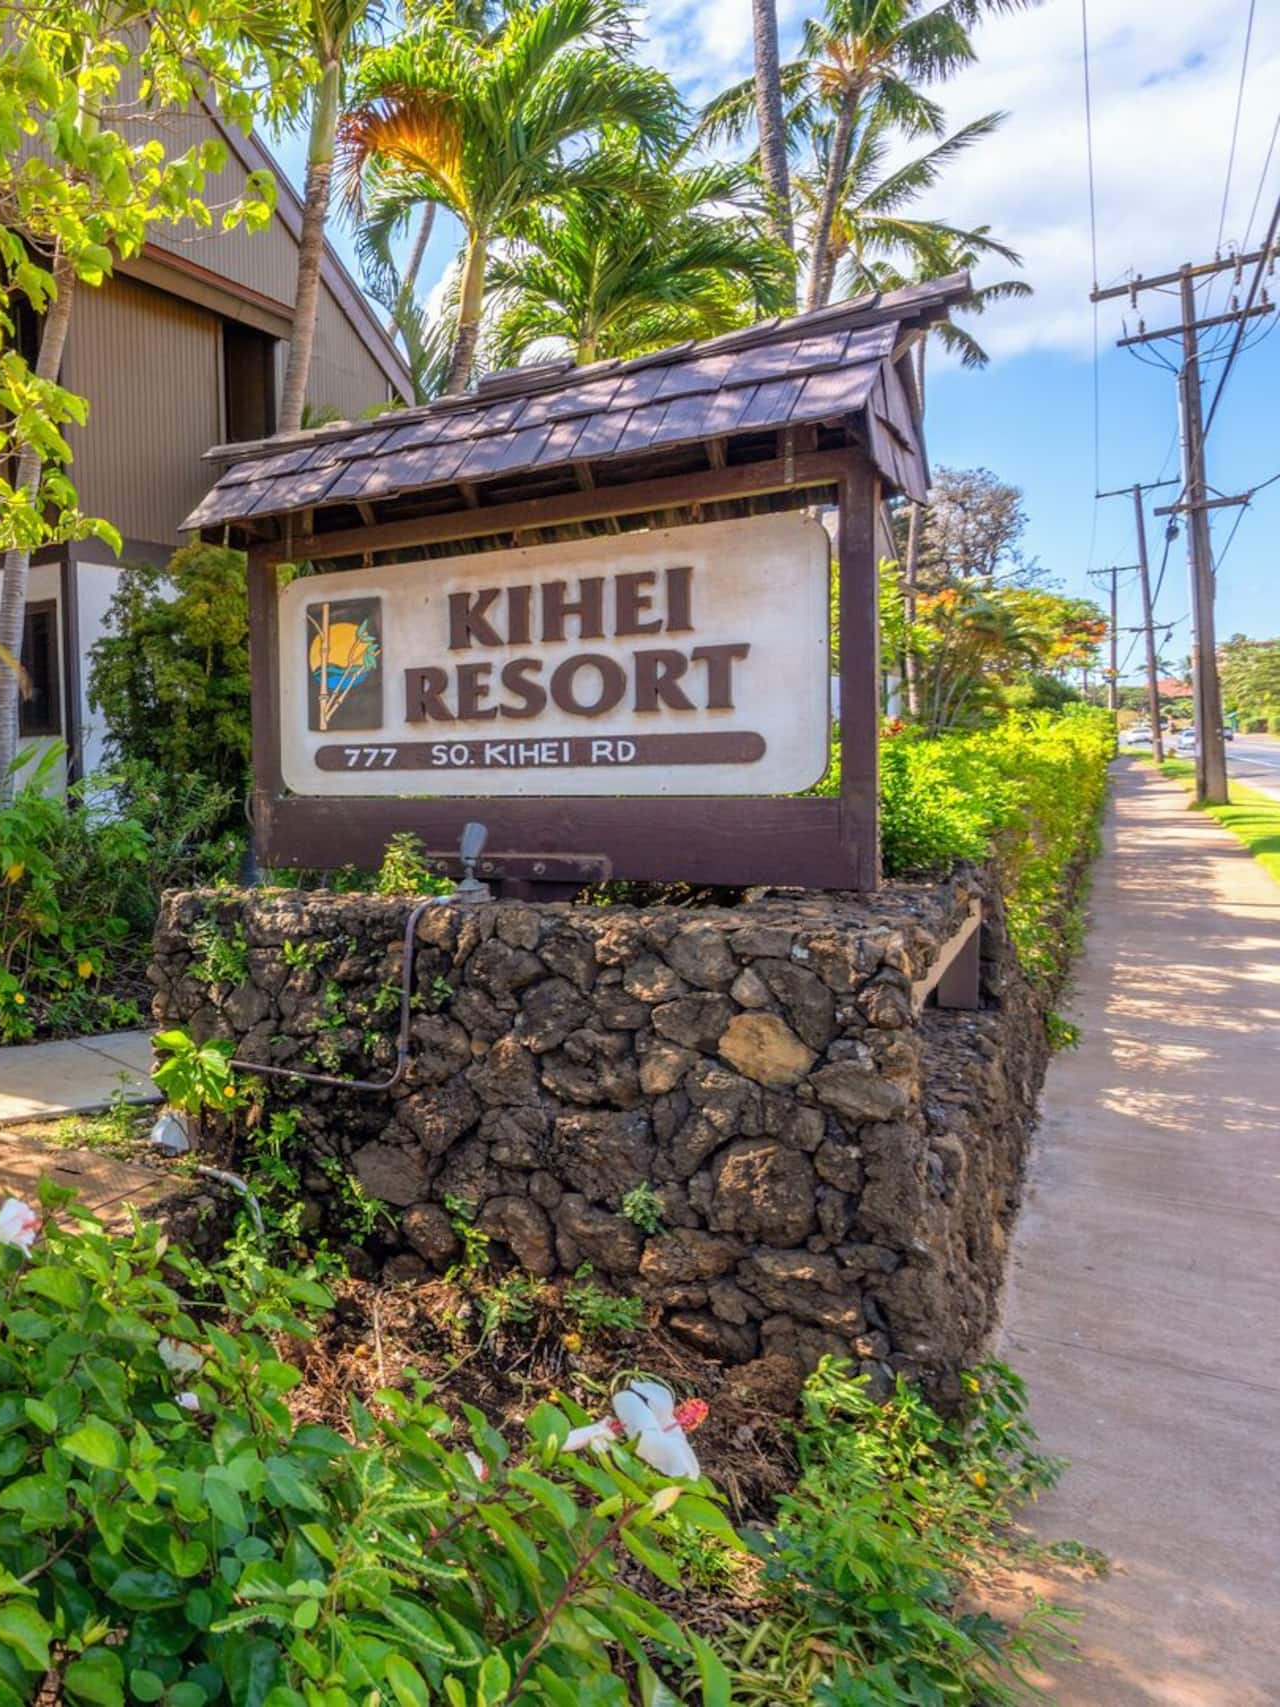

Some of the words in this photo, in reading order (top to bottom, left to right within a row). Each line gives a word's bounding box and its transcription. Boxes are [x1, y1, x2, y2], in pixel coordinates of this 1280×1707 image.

[448, 566, 695, 650] KIHEI
[404, 643, 751, 724] RESORT
[344, 748, 398, 768] 777
[431, 743, 475, 766] SO.
[484, 742, 570, 766] KIHEI
[591, 741, 637, 764] RD
